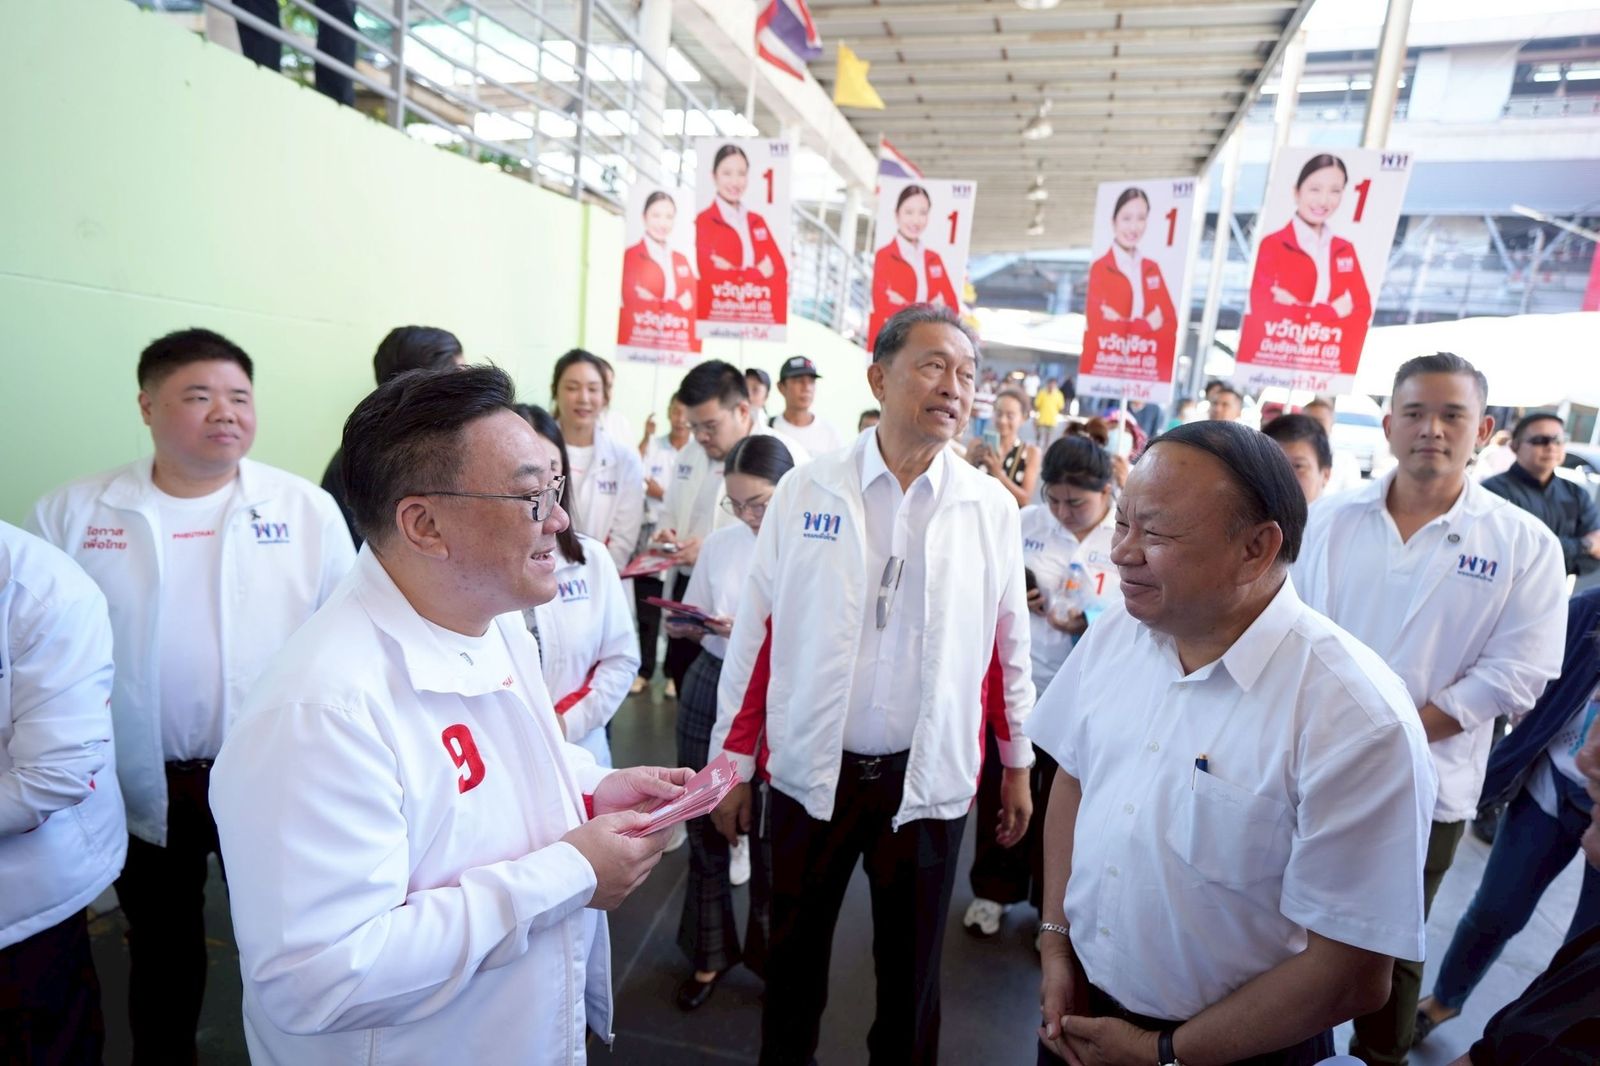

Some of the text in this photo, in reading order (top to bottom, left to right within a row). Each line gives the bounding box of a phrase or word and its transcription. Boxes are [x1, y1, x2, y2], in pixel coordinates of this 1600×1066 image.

[763, 168, 773, 204] 1
[1353, 179, 1371, 222] 1
[948, 211, 958, 244] 1
[1165, 208, 1177, 247] 1
[1265, 318, 1342, 343] ขวัญจิรา
[87, 526, 125, 536] โอกาส
[252, 523, 289, 538] พท
[804, 512, 841, 534] พท
[83, 537, 127, 550] เพื่อไทย
[1459, 554, 1498, 577] พท
[1095, 572, 1105, 595] 1
[442, 723, 486, 794] 9
